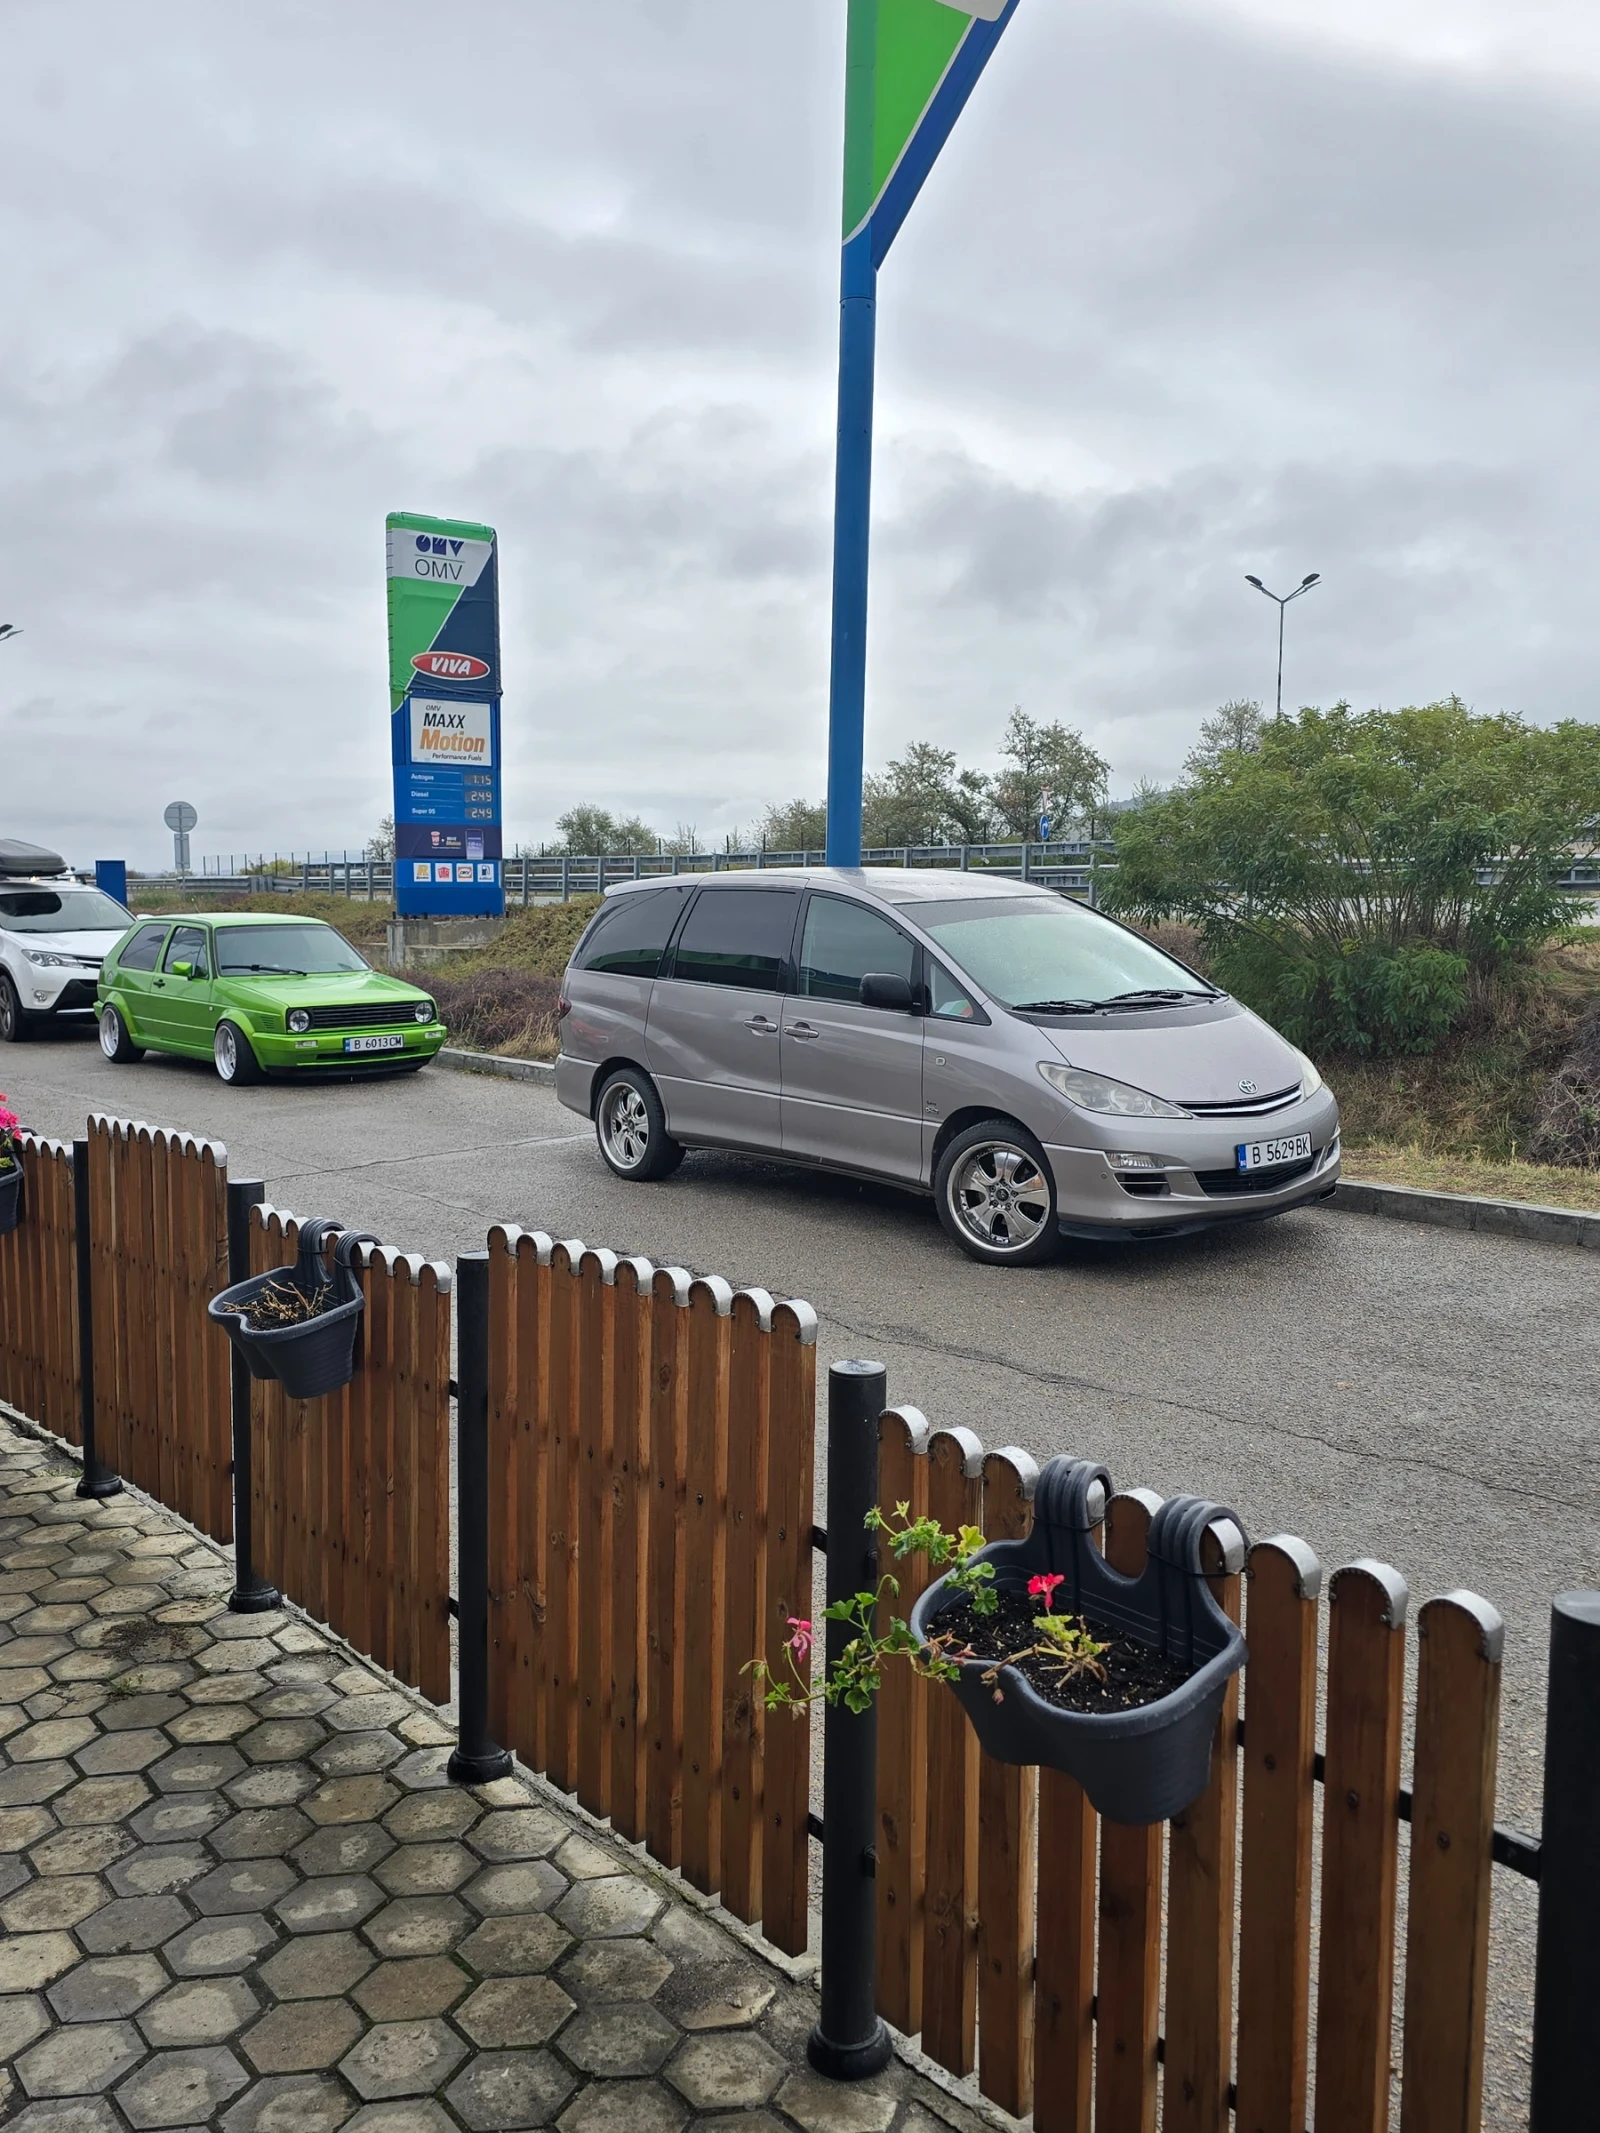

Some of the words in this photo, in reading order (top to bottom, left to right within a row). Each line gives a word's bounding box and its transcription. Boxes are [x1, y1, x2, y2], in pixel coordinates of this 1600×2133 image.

[415, 559, 463, 580] OMV
[431, 657, 471, 675] VIVA
[423, 713, 466, 728] MAXX
[420, 728, 485, 752] Motion
[473, 775, 492, 785] 1.15
[471, 791, 492, 802] 2.49
[471, 808, 492, 819] 2.49
[354, 1040, 361, 1049] B
[1253, 1146, 1261, 1164] B
